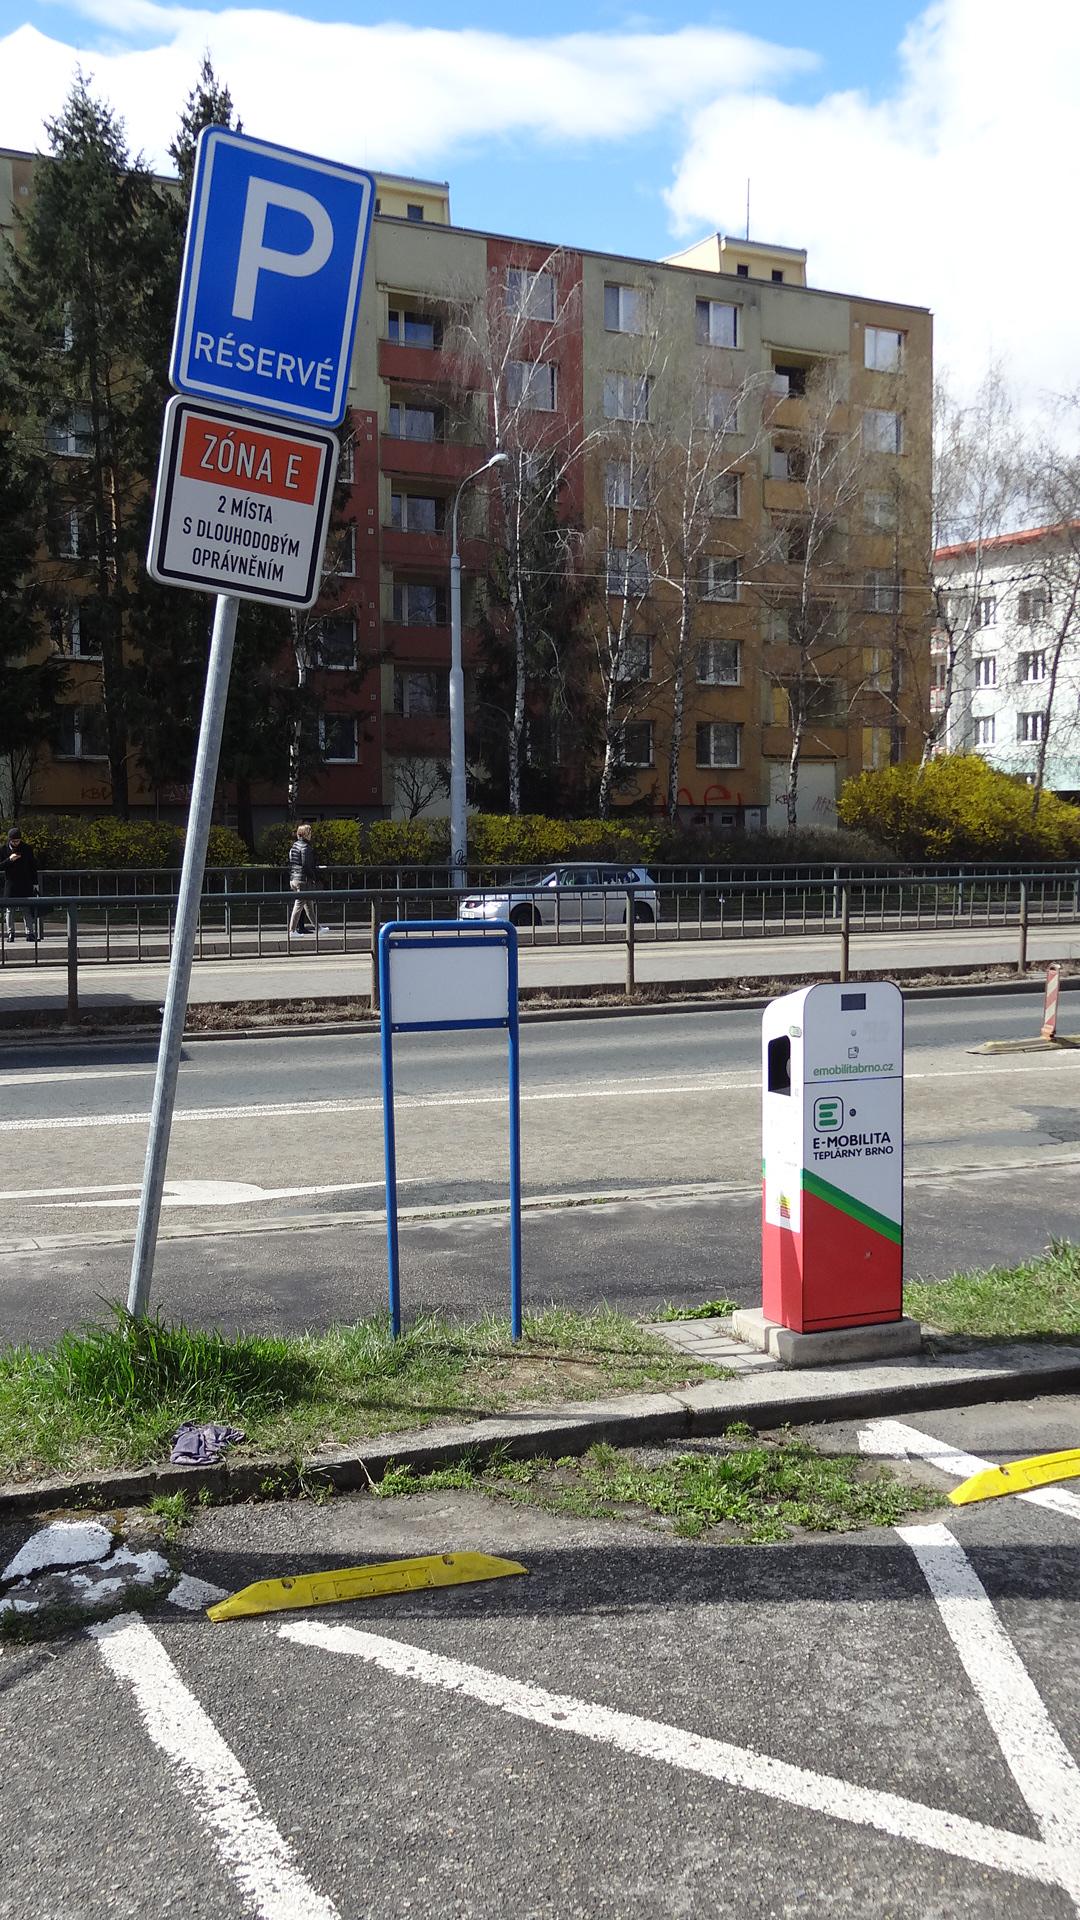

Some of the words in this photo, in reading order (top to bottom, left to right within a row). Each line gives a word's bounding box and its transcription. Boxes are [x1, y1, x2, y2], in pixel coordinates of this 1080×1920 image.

[232, 176, 334, 321] P
[194, 331, 334, 392] RÉSERVÉ
[200, 431, 272, 484] ZÓNA
[285, 454, 303, 489] E
[217, 495, 226, 514] 2
[231, 496, 273, 524] MÍSTA
[182, 517, 192, 534] S
[197, 519, 300, 558] DLOUHODOBÝM
[192, 547, 284, 582] OPRÁVNĚNÍM
[813, 1063, 894, 1076] emobilitabrno.cz
[813, 1132, 891, 1150] E-MOBILITA
[813, 1147, 862, 1160] TEPLÁRNY
[865, 1145, 894, 1156] BRNO
